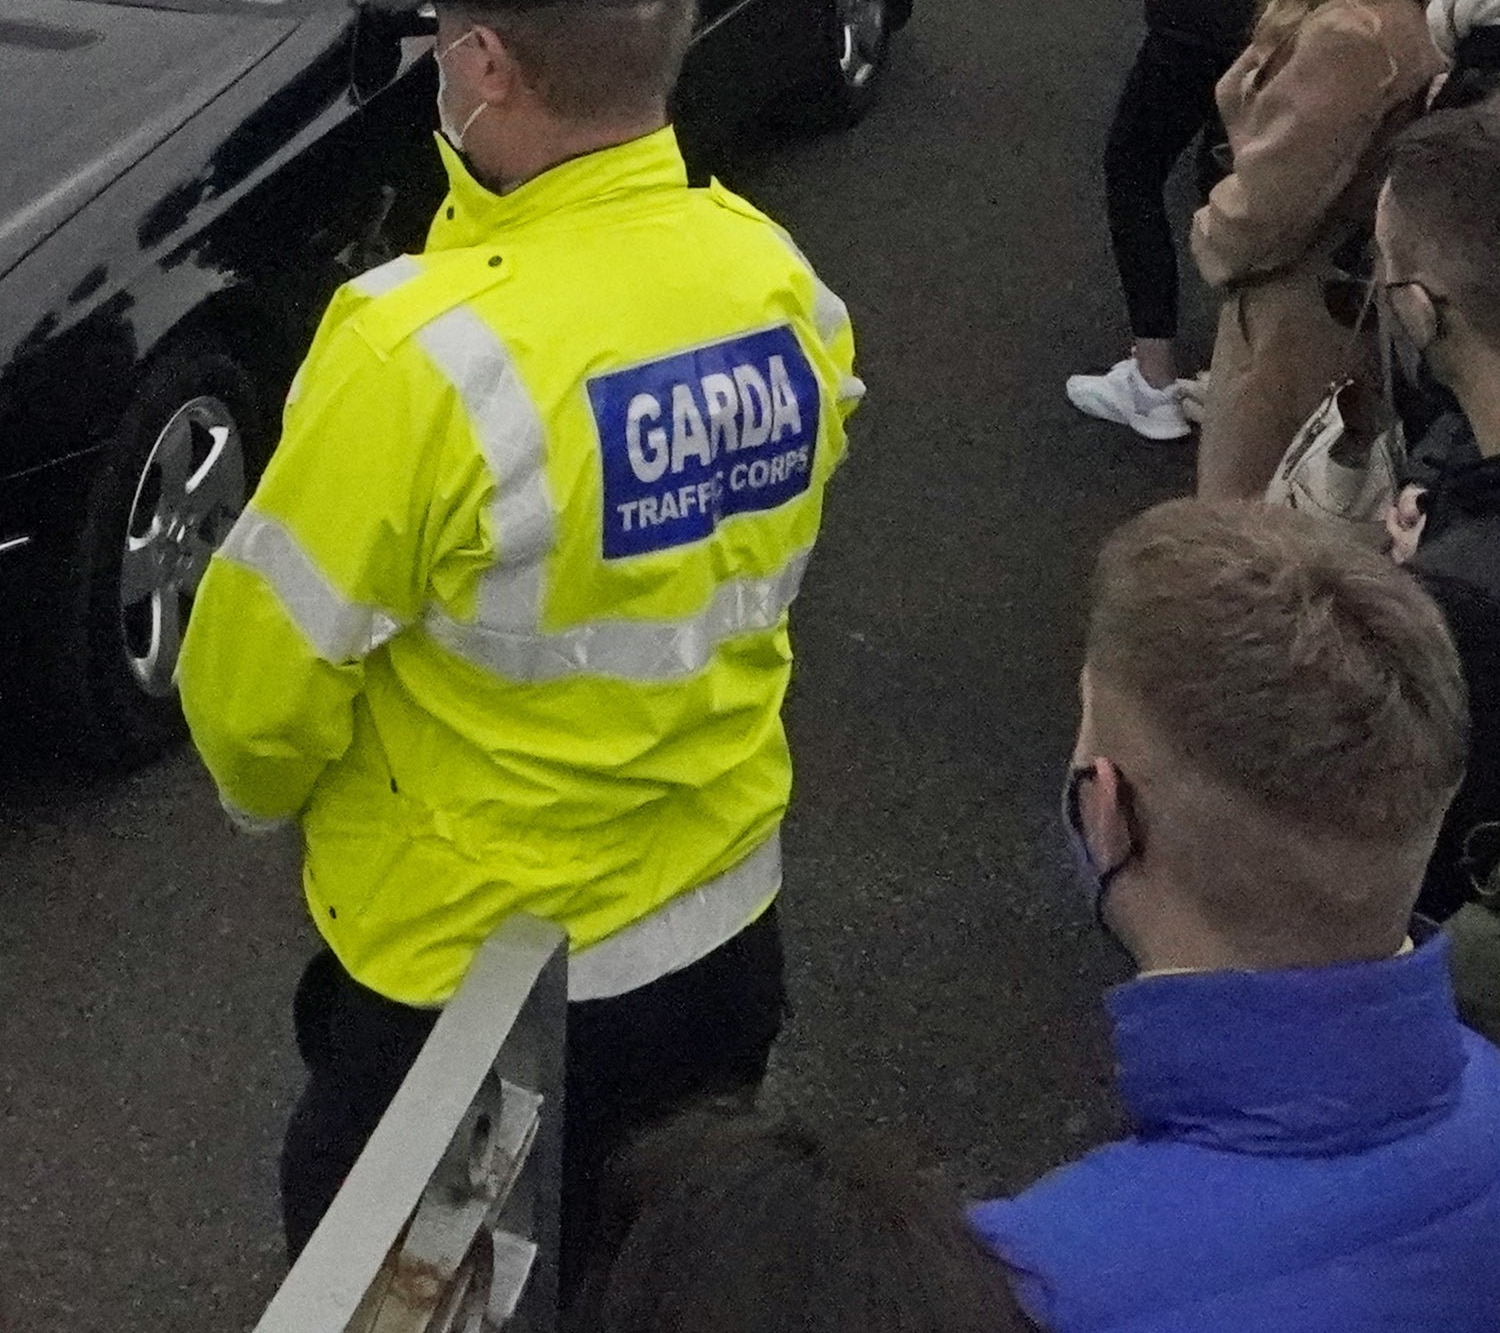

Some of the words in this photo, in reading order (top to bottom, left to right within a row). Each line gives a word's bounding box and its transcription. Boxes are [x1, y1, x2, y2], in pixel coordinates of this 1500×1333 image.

[625, 354, 802, 484] GARDA
[617, 470, 725, 533] TRAFFC
[730, 444, 809, 493] CORPS
